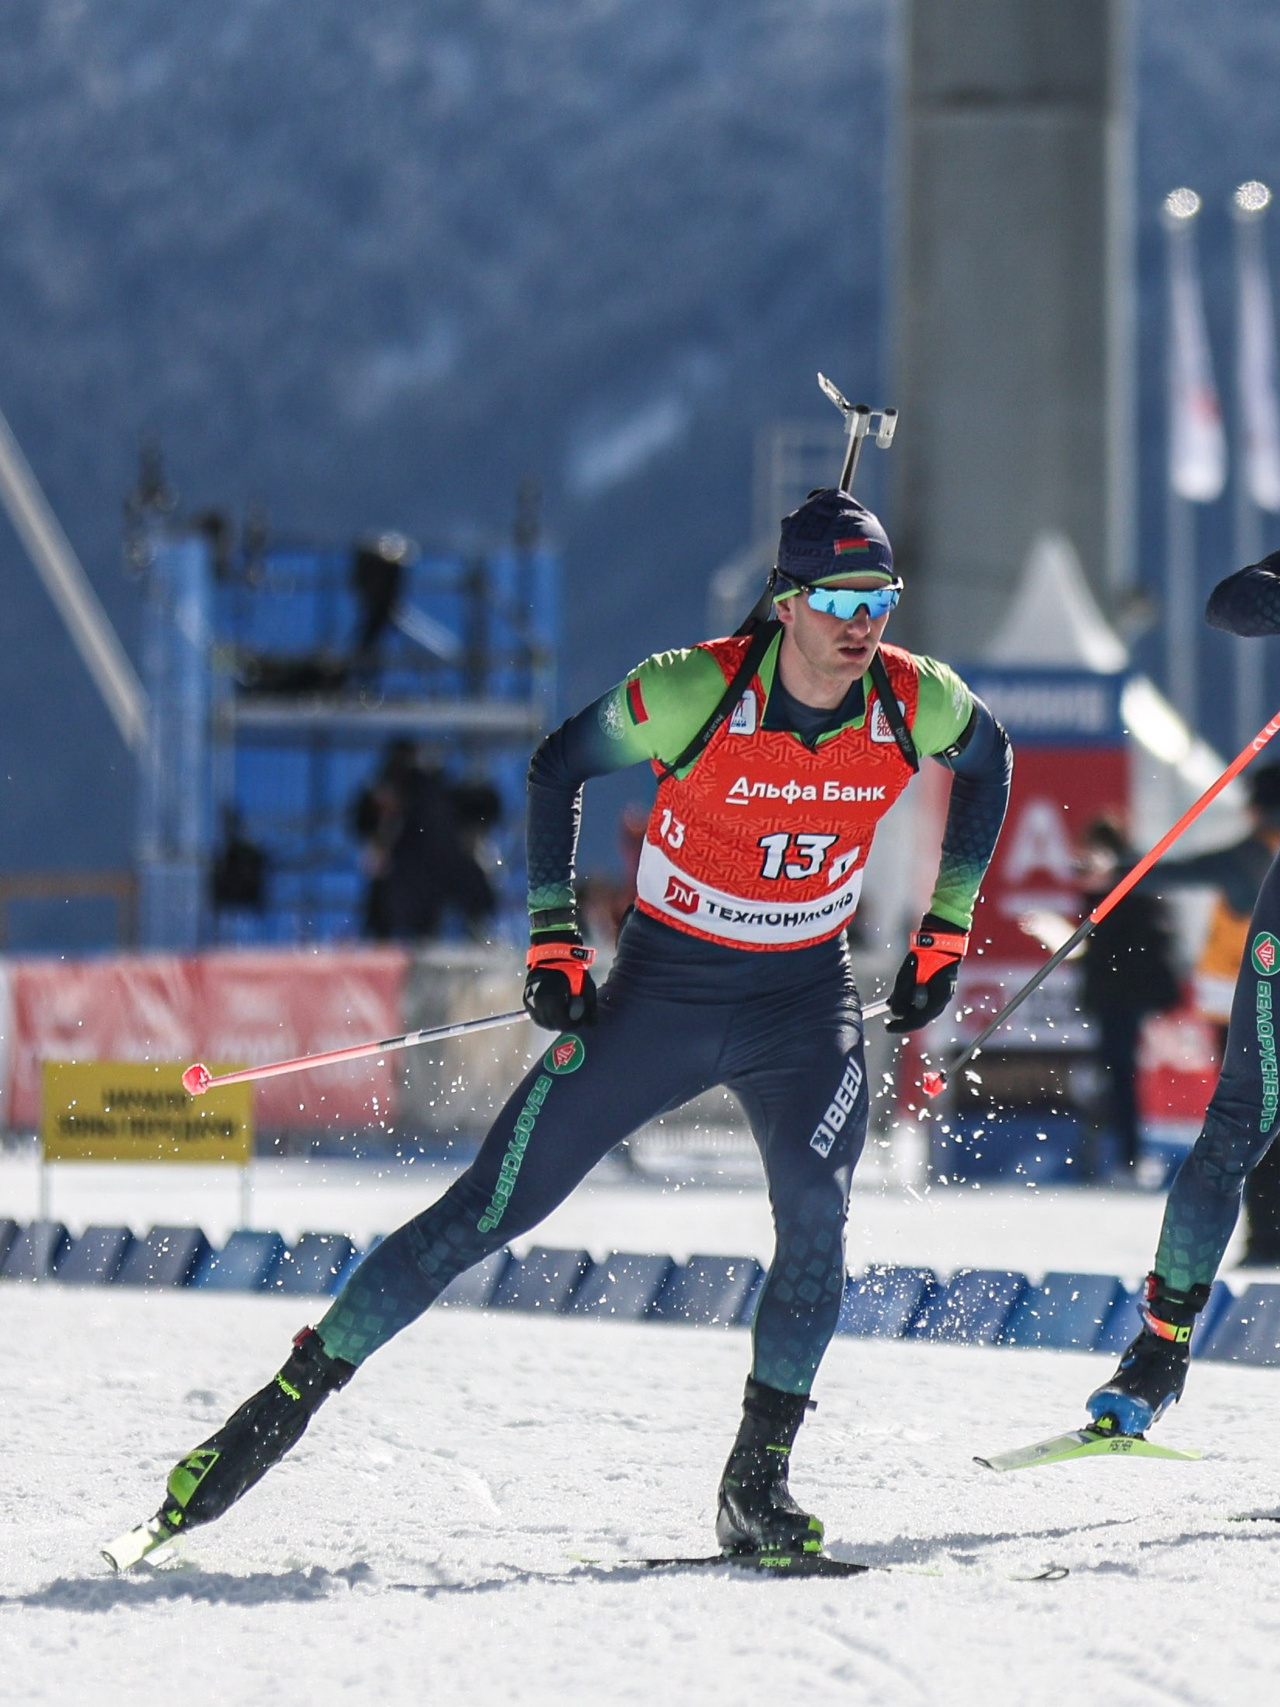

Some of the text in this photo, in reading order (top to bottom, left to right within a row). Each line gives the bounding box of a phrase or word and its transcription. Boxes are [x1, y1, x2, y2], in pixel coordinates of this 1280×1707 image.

[727, 777, 886, 804] Альфа Банк
[659, 808, 686, 849] 13
[757, 832, 839, 880] 13
[1257, 981, 1279, 1133] БЕЛОРУСНЕФТЬ
[823, 1056, 863, 1133] BEEU
[477, 1074, 553, 1233] БЕЛОРУСНЕФТЬ
